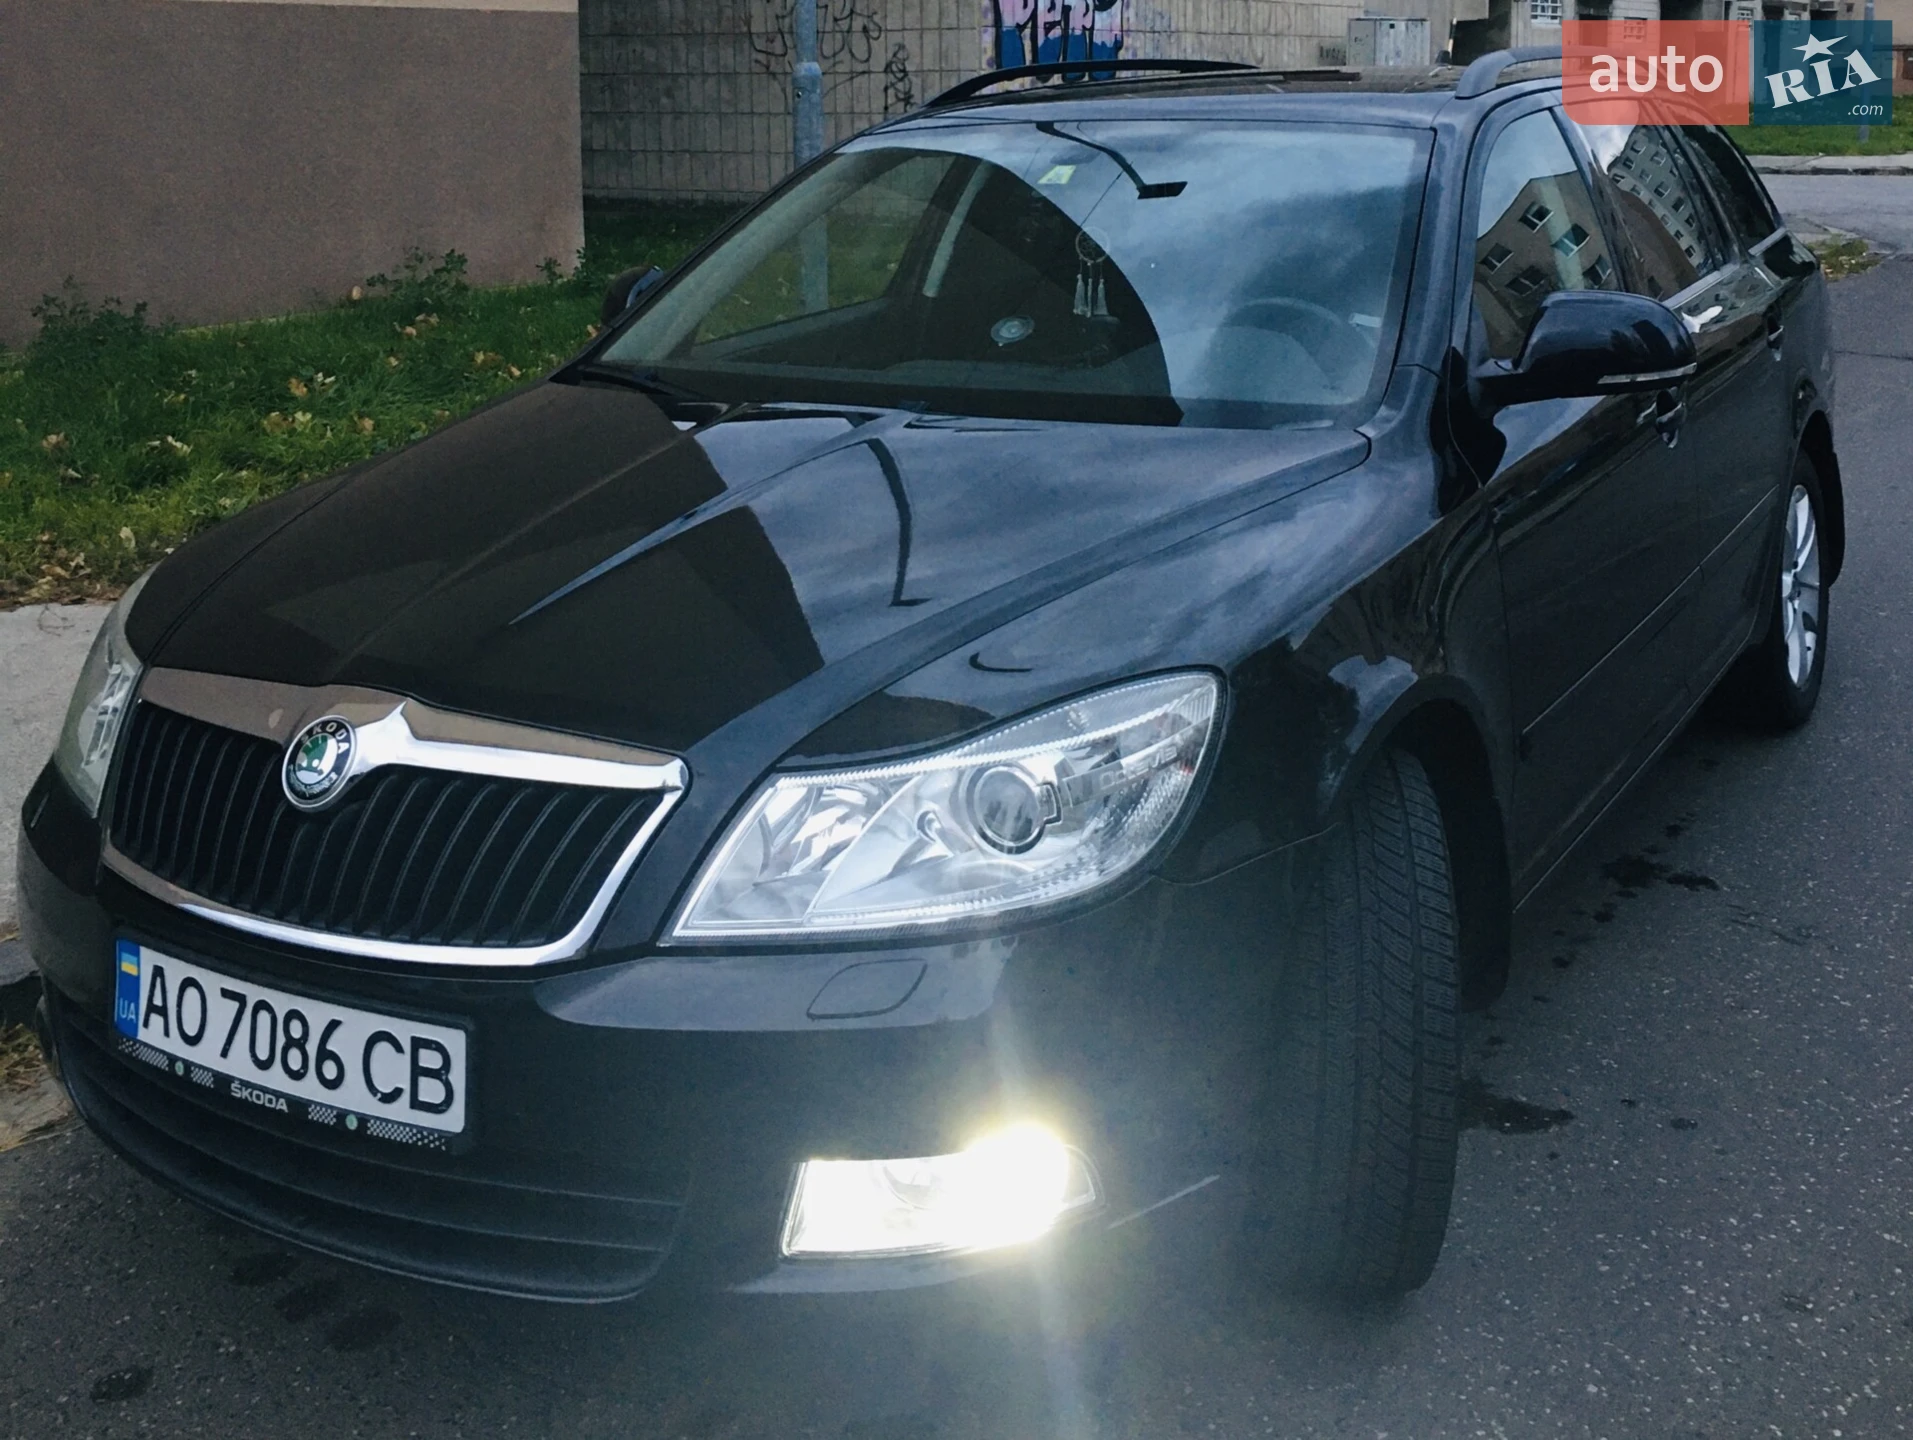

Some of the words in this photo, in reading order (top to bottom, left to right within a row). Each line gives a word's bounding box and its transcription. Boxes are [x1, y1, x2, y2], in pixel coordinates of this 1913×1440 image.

[120, 997, 137, 1024] UA
[142, 964, 208, 1047] AO
[220, 987, 345, 1090] 7086
[362, 1030, 454, 1115] CB
[230, 1080, 289, 1113] ŠKODA
